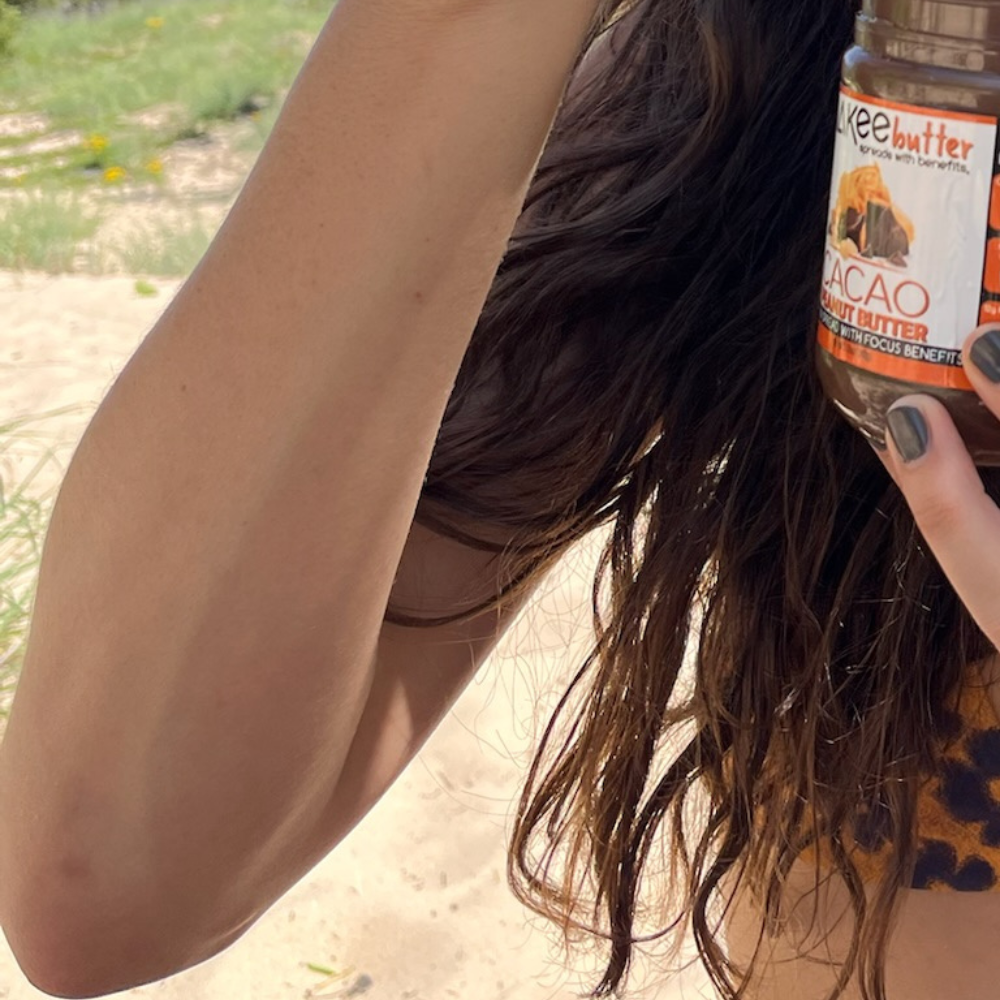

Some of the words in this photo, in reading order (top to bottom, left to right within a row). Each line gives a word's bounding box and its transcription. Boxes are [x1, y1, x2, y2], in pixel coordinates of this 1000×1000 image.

[895, 153, 915, 164] with
[822, 288, 856, 323] EANUT
[857, 307, 930, 343] BUTTER
[840, 323, 863, 344] WITH
[864, 333, 901, 355] FOCUS
[904, 344, 963, 366] BENEFITS
